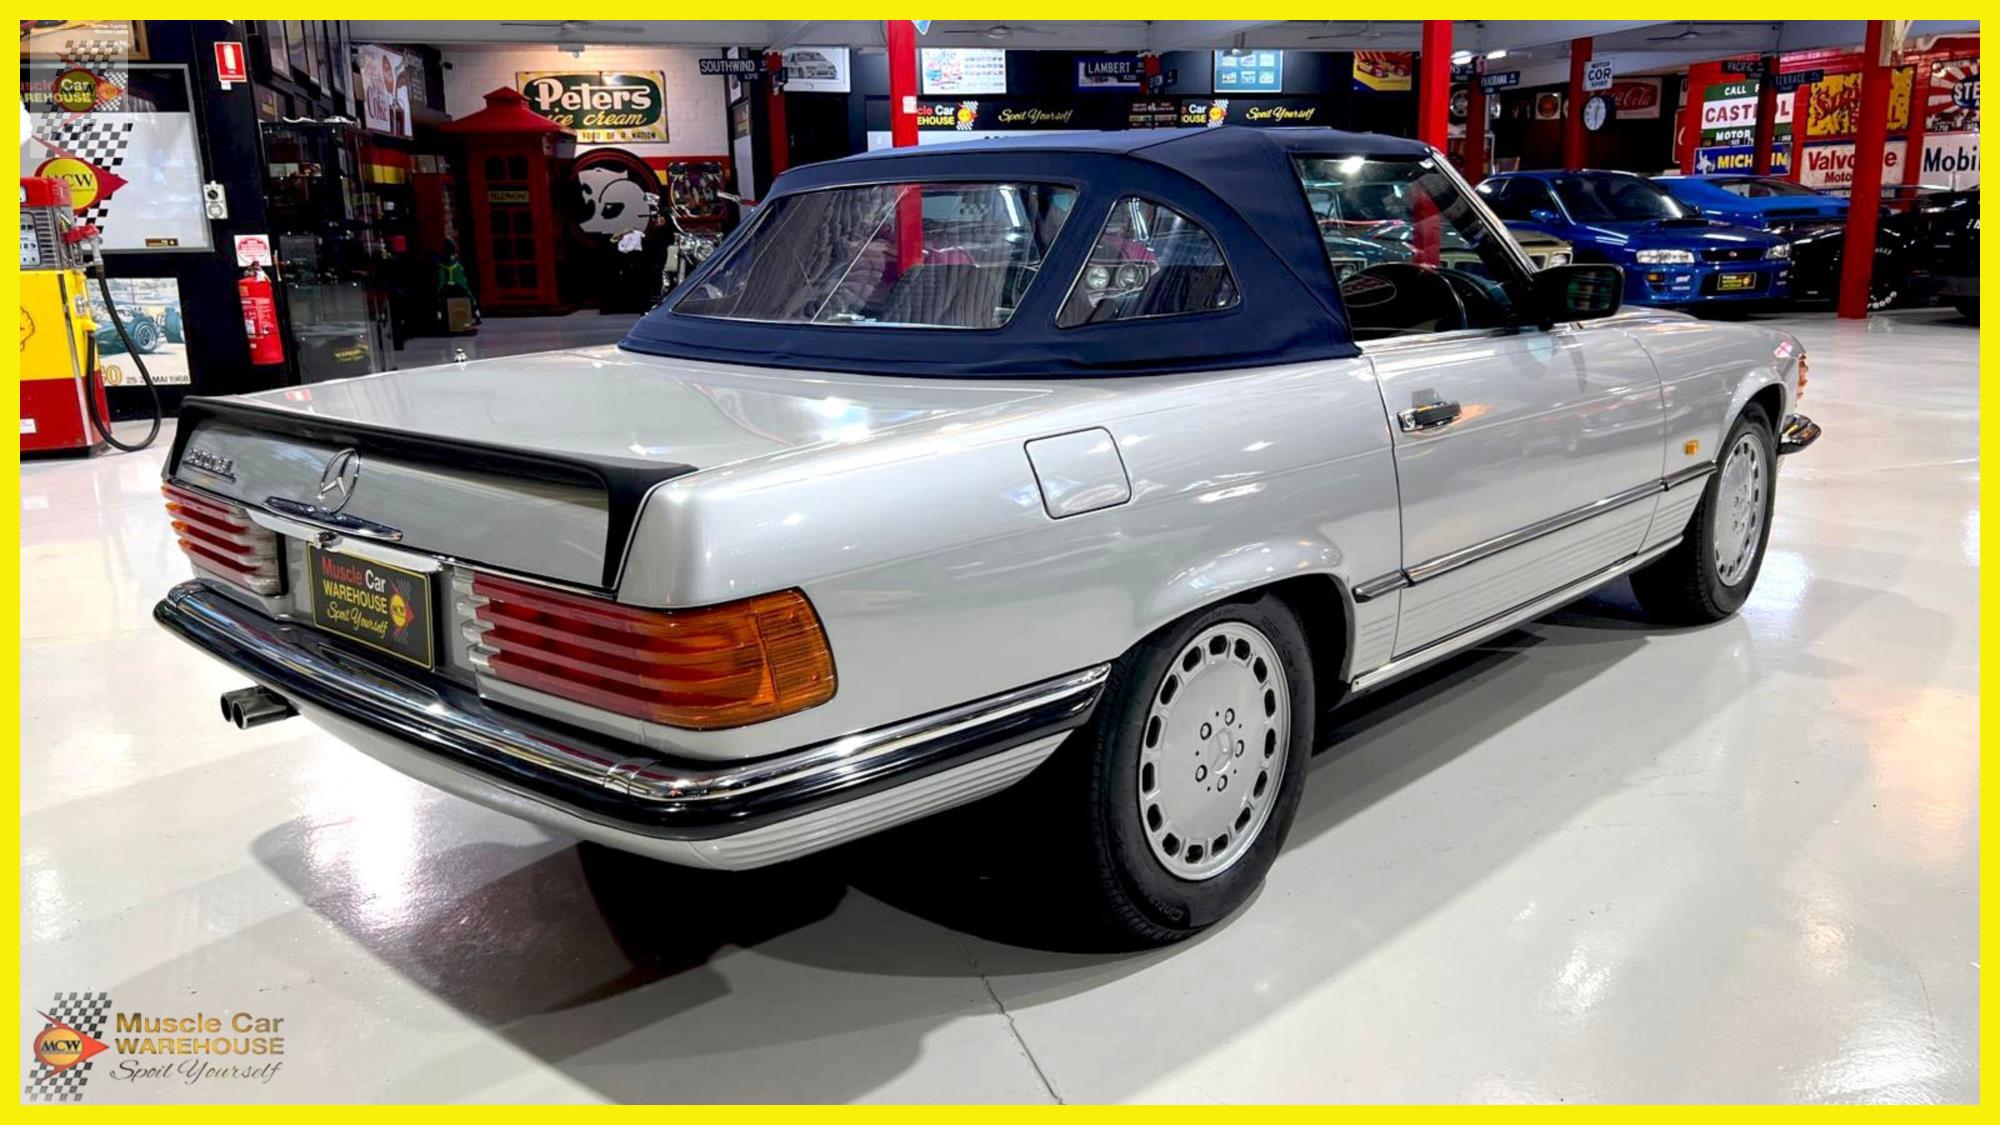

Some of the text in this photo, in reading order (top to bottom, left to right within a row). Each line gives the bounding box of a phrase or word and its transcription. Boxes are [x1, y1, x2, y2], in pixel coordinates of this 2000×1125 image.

[701, 60, 755, 73] SOUTHWIND
[1087, 62, 1131, 74] LAMBERT
[1588, 68, 1611, 81] COR
[533, 78, 652, 111] Peters
[1724, 87, 1746, 96] CALL
[1954, 80, 1980, 101] STE
[934, 105, 955, 115] Car
[1027, 107, 1074, 124] Yourself
[1189, 104, 1207, 114] Car
[1272, 106, 1316, 122] Yourself
[1705, 101, 1790, 122] CASTL
[583, 110, 647, 125] cream
[918, 115, 955, 125] EHOUSE
[1716, 129, 1751, 141] MOTOR
[1717, 152, 1788, 169] MICHIN
[1924, 147, 1980, 172] Mobi
[1825, 172, 1852, 183] Moto
[320, 556, 386, 593] Muscle Car
[323, 579, 388, 615] WAREHOUSE
[327, 601, 389, 638] Spoil Yourself
